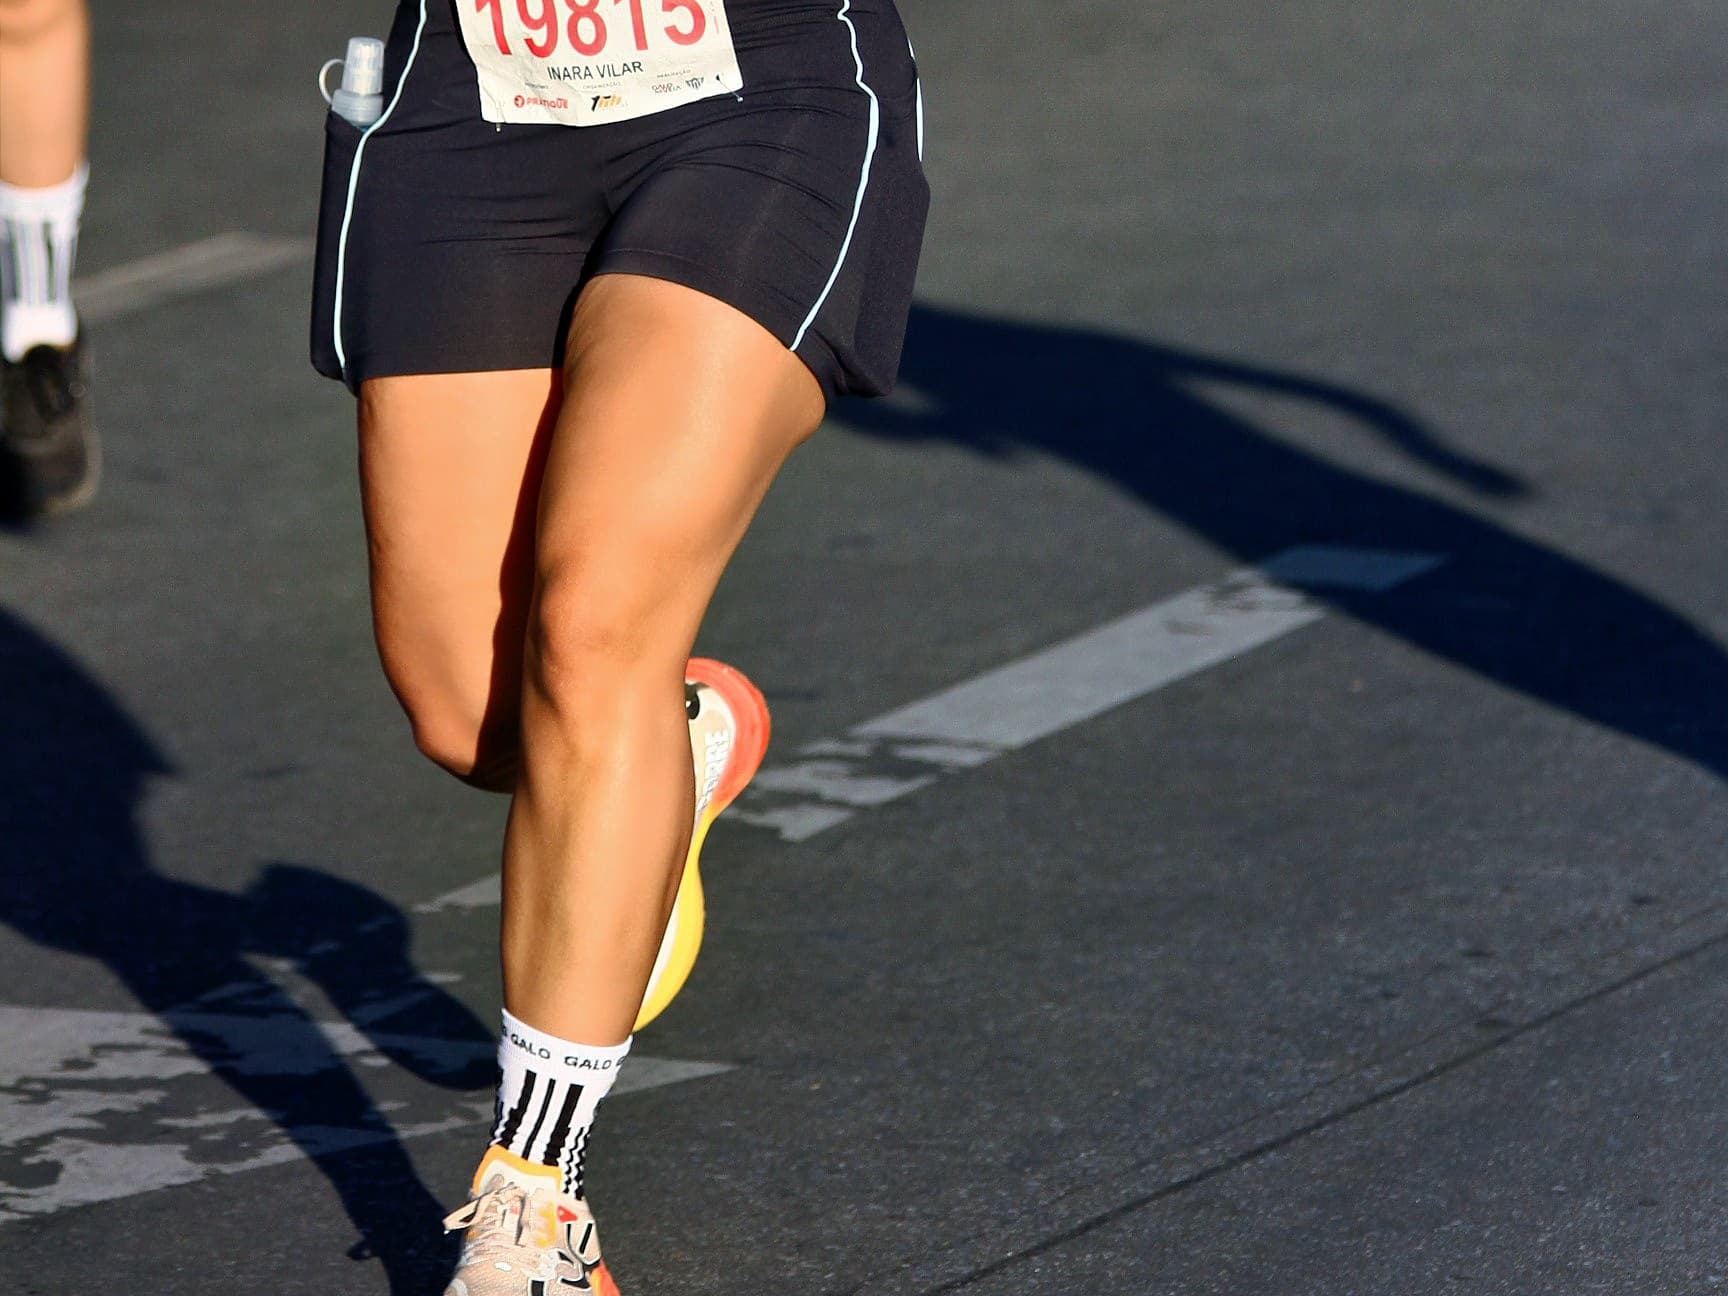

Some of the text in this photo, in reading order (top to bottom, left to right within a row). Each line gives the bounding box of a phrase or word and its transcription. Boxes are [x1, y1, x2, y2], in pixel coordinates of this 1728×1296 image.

[547, 61, 643, 80] INARA VILAR
[510, 1033, 551, 1059] GALO
[564, 1056, 612, 1070] GALO
